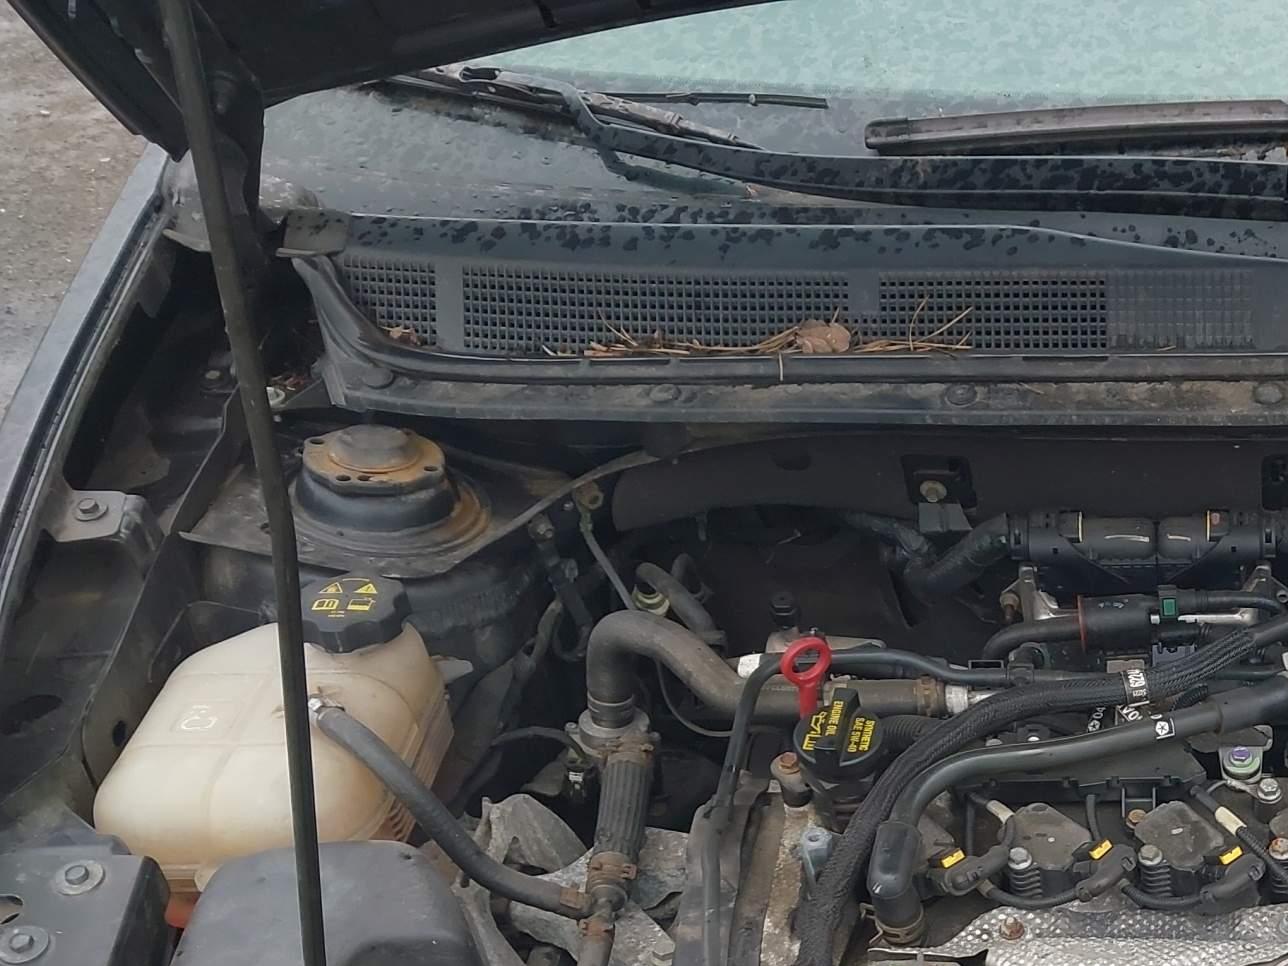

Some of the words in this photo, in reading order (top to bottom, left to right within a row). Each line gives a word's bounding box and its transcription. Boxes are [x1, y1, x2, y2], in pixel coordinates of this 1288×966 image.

[830, 701, 843, 723] ENGINE
[826, 725, 838, 735] OIL
[853, 718, 864, 730] SAE
[859, 720, 875, 751] SYNTHETIC
